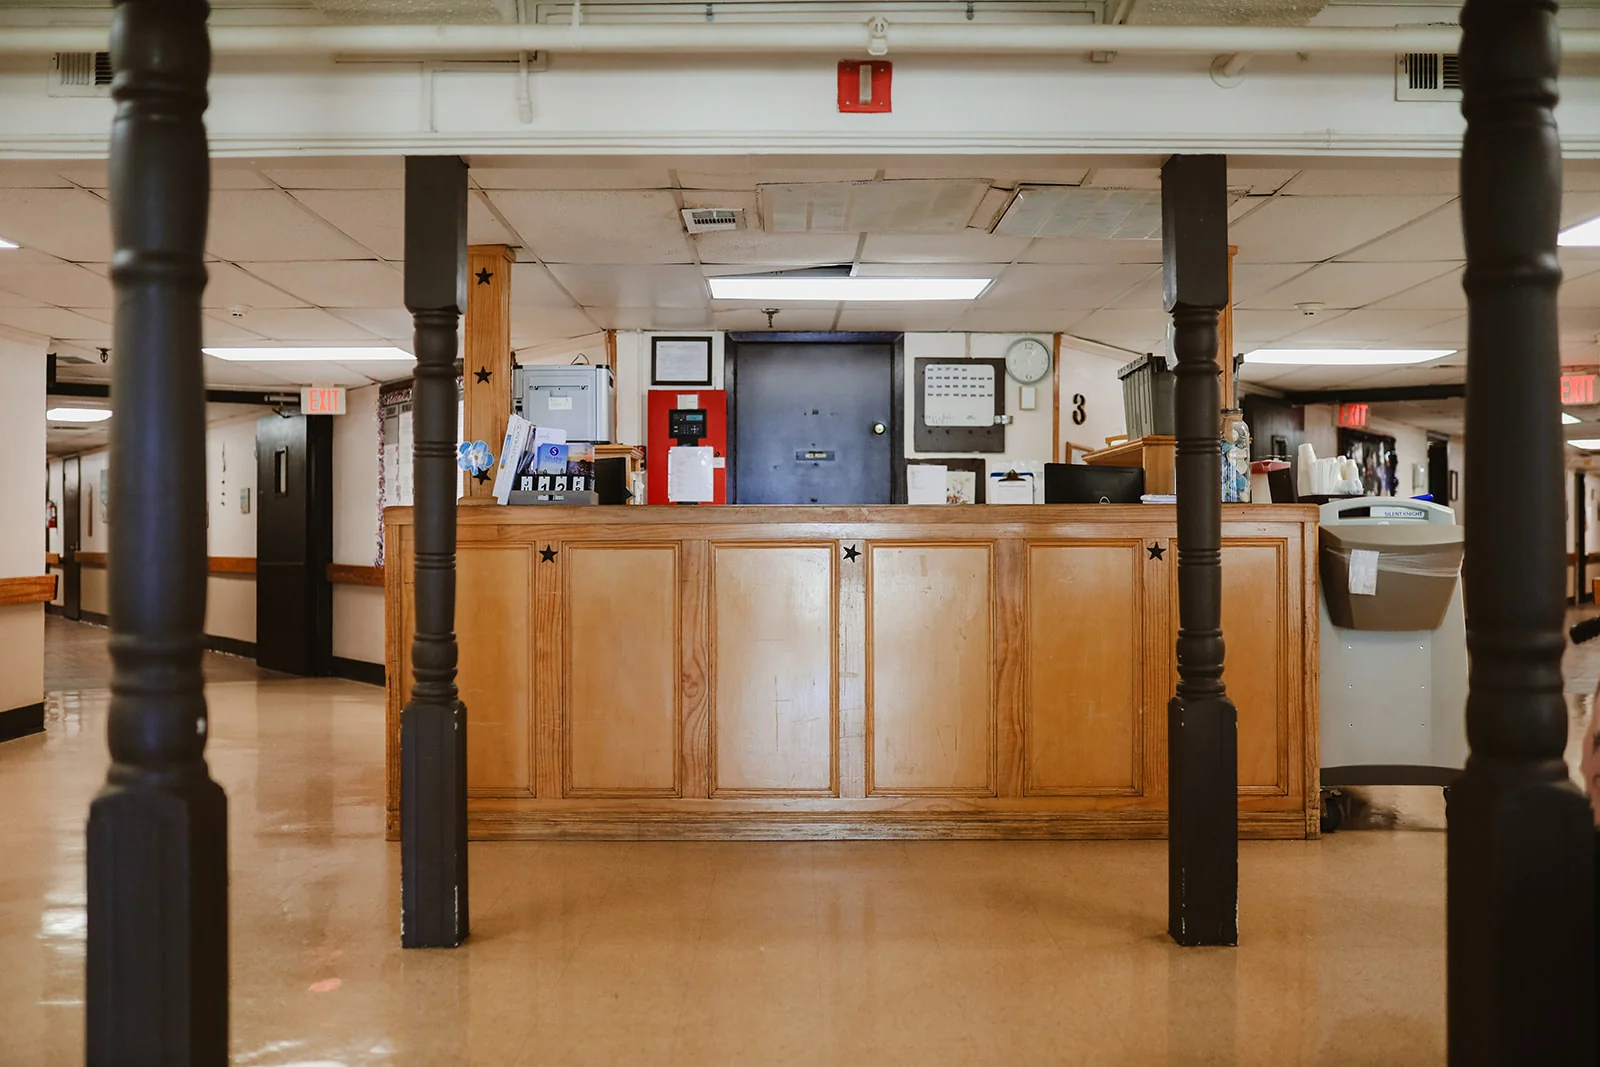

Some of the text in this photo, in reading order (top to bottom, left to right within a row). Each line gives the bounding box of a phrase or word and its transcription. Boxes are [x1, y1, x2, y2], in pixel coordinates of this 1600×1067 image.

[308, 389, 340, 412] EXIT
[1559, 375, 1595, 403] EXIT
[1072, 393, 1087, 425] 3
[1338, 402, 1369, 427] EXIT
